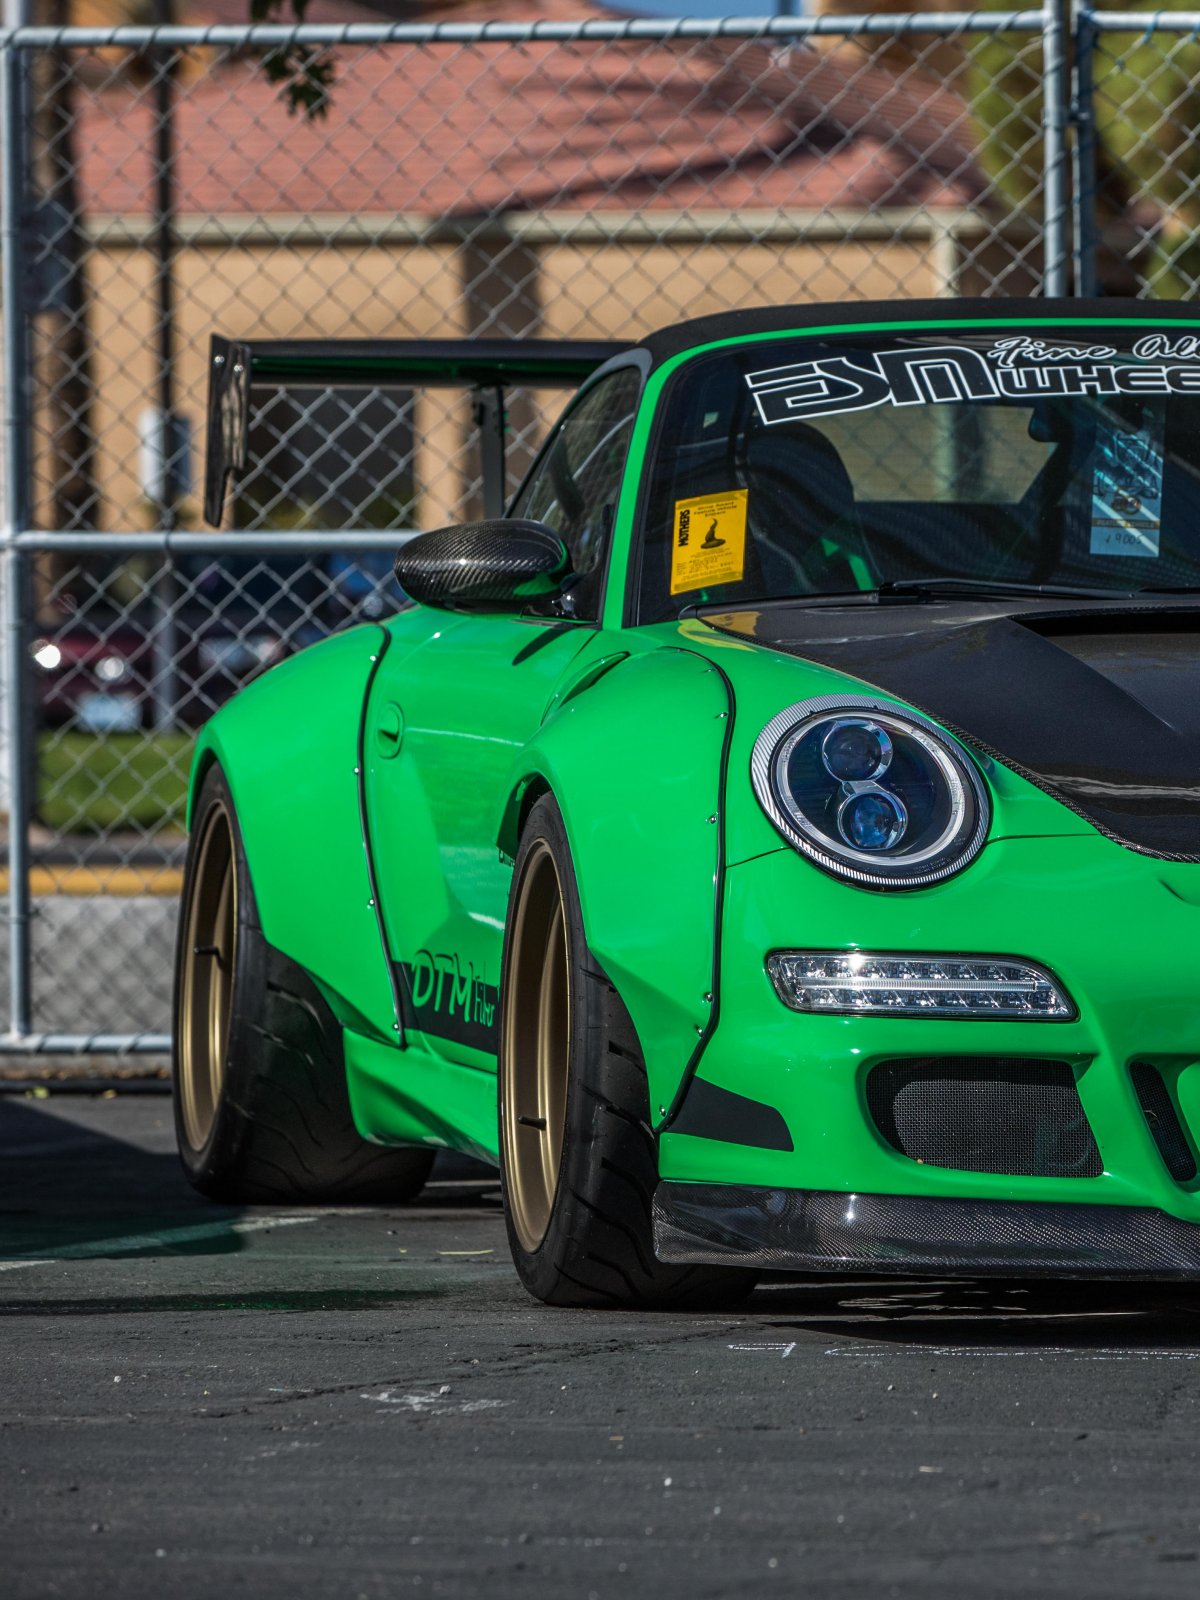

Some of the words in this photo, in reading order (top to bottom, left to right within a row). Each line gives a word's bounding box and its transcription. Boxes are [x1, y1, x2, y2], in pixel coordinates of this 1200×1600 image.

[988, 336, 1117, 368] Fine
[678, 509, 690, 547] MOTHERS
[412, 948, 474, 1023] DTM
